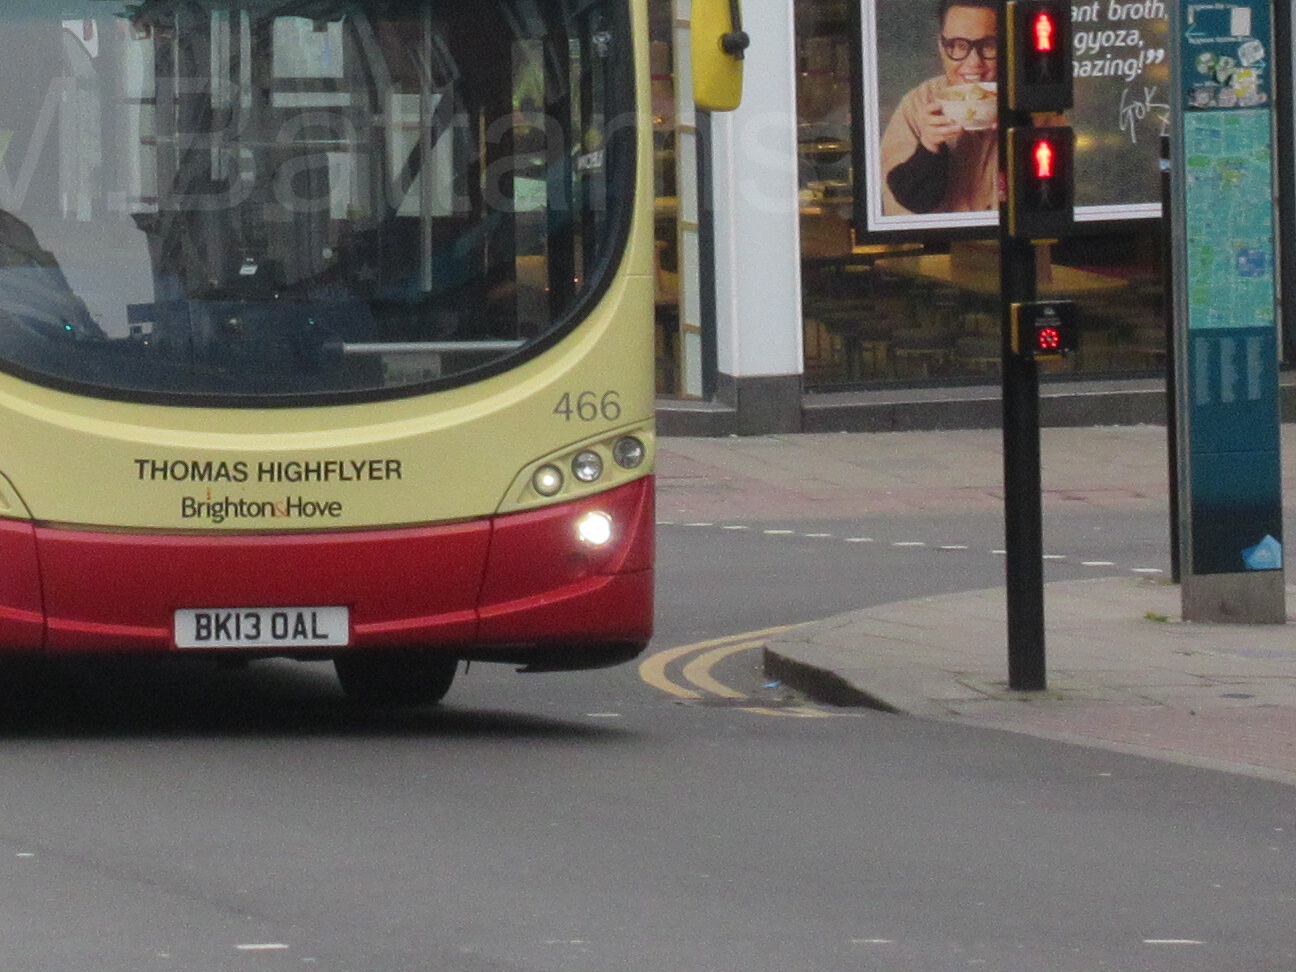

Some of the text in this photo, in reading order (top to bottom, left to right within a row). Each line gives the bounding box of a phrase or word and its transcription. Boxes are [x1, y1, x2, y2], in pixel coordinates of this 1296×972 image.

[1073, 29, 1145, 56] gyoza,
[552, 390, 622, 422] 466
[134, 459, 403, 482] THOMAS HIGHFLYER
[194, 611, 329, 642] BK13 OAL
